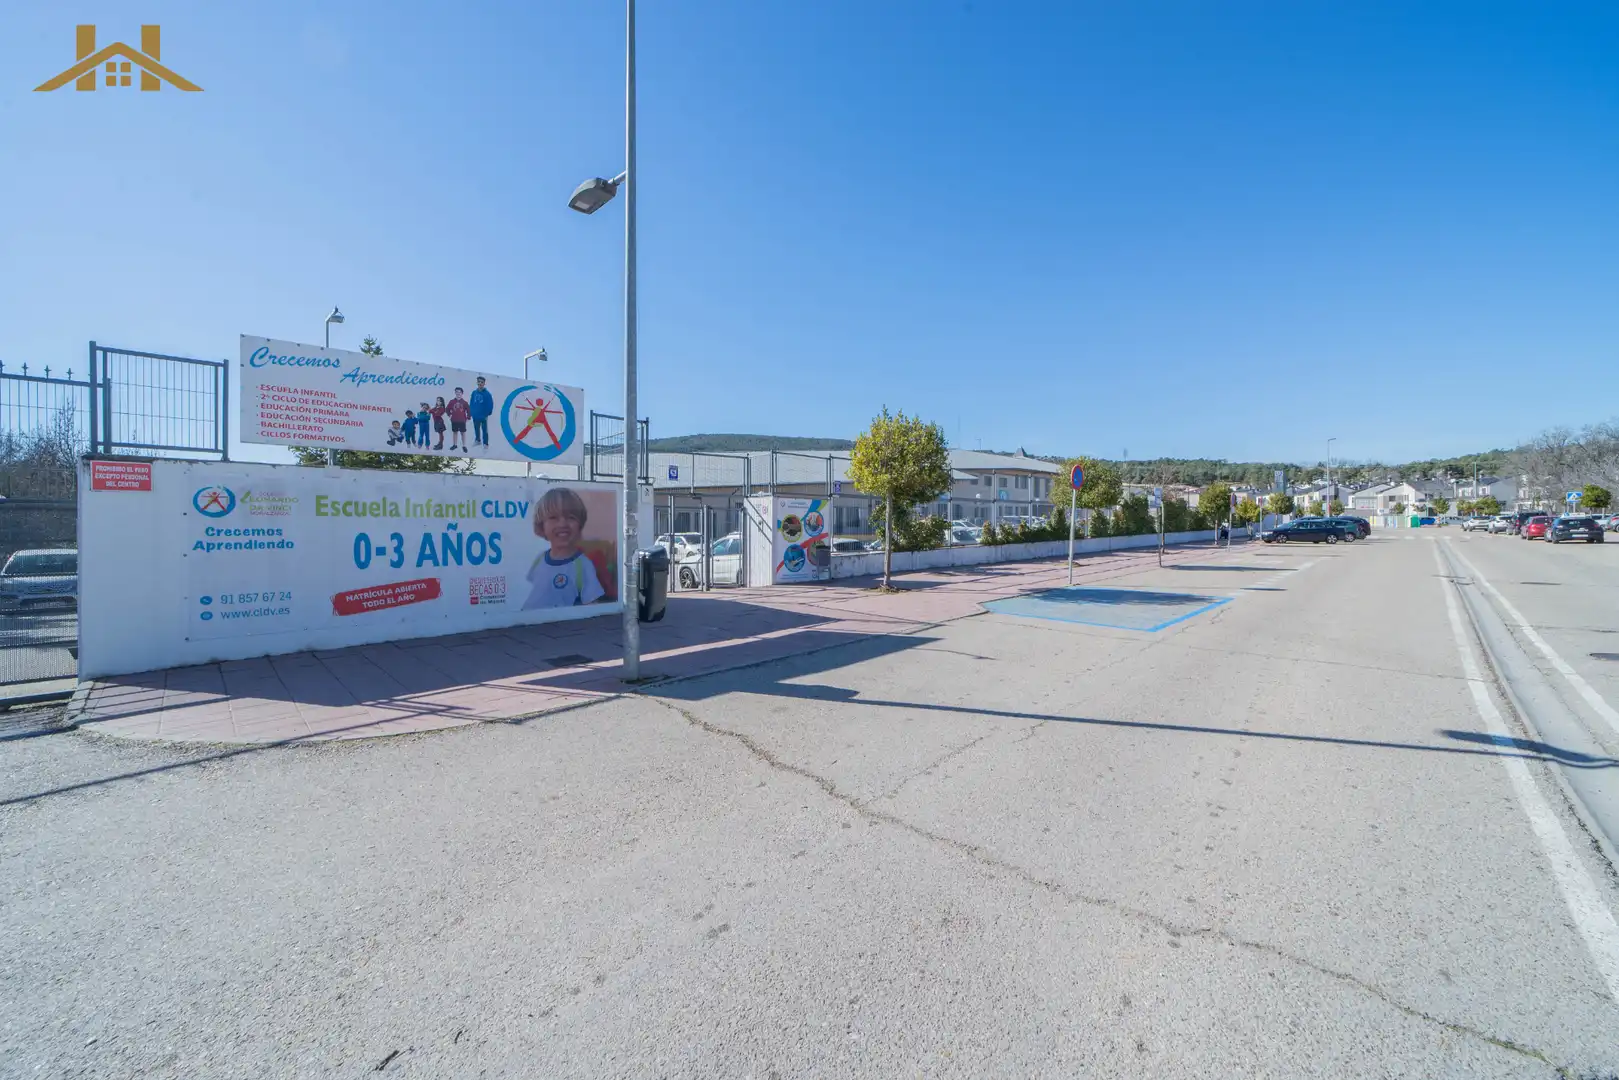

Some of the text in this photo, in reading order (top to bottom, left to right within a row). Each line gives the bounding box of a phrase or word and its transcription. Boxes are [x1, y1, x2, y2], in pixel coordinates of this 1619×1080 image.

[250, 346, 341, 368] Crecemos
[340, 366, 446, 388] Aprendiendo
[300, 388, 338, 399] INFANTIL
[260, 402, 312, 414] EDUCACIÓN
[271, 394, 297, 403] CICLO
[298, 397, 310, 405] DE
[311, 399, 359, 411] EDUCACIÓN
[359, 404, 393, 414] INFANTIL
[260, 411, 364, 428] EDUCACIÓN SECUNDARIA
[260, 421, 324, 433] BACHILLERATO
[260, 430, 346, 443] CICLOS FORMATIVOS
[315, 494, 530, 520] Escuela Infantil CLDV
[205, 526, 284, 537] Crecemos
[192, 539, 295, 553] Aprendiendo
[353, 522, 504, 570] 0-3 AÑOS
[345, 582, 428, 602] MATRÍCULA ABIERTA
[469, 583, 493, 596] BECAS
[220, 591, 292, 605] 91 857 67 24
[362, 599, 386, 609] TODO
[397, 592, 416, 602] AÑO
[220, 606, 291, 620] www.cldv.es
